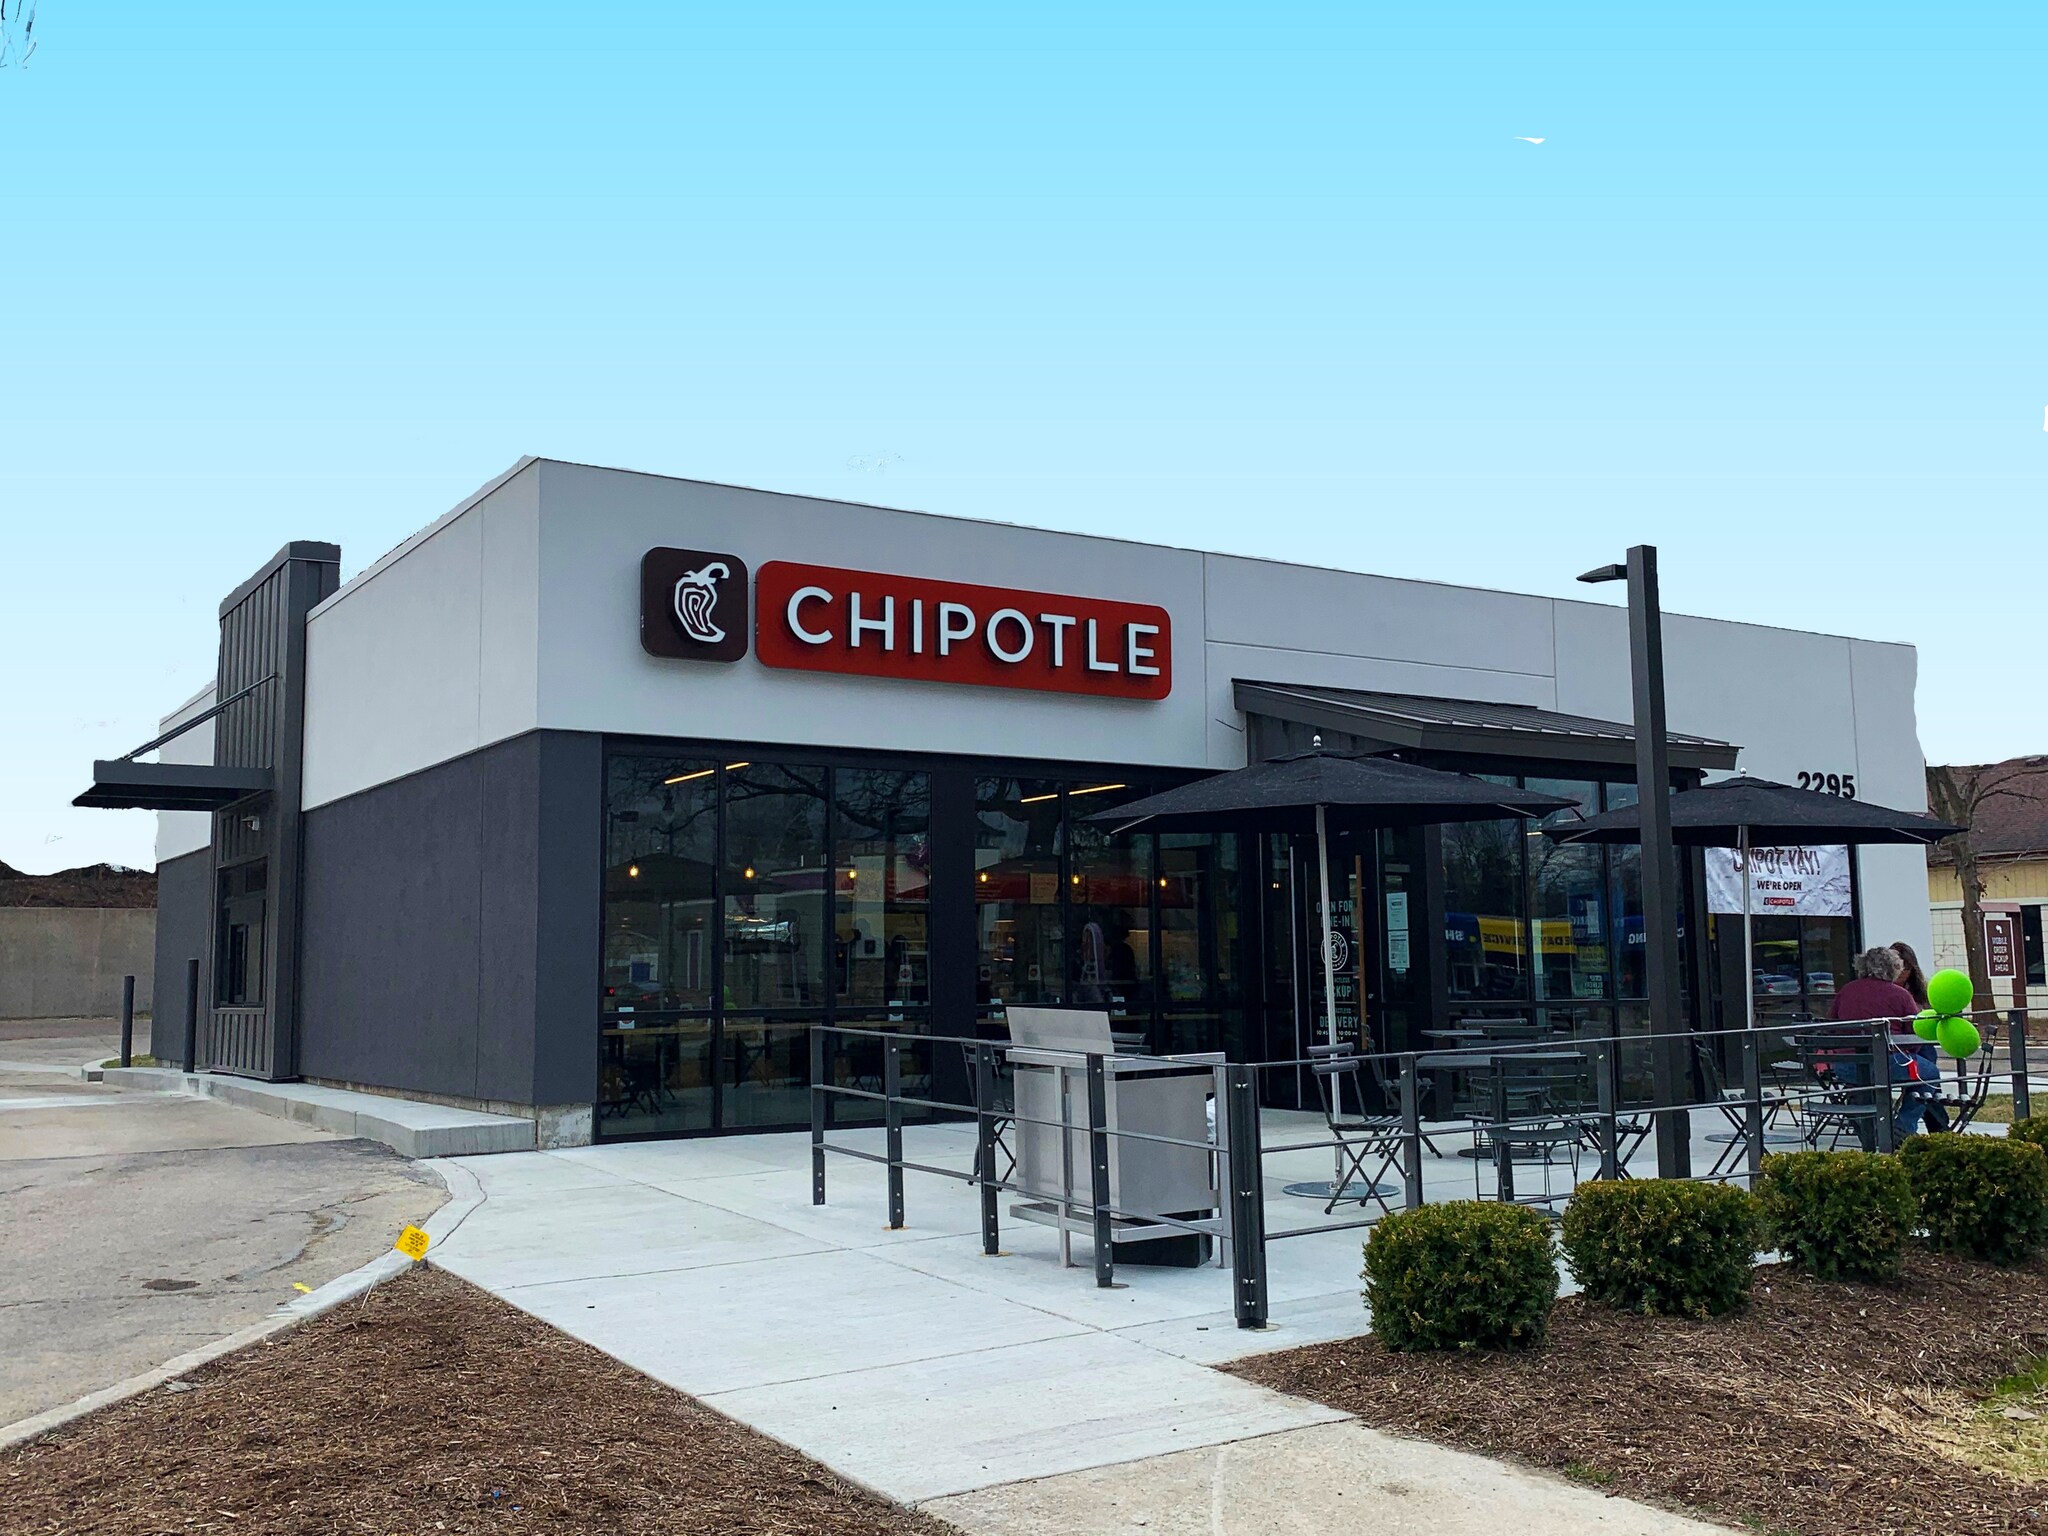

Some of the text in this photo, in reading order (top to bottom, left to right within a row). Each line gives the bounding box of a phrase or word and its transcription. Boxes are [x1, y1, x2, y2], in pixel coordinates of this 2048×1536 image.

[786, 586, 1160, 676] CHIPOTLE
[1797, 771, 1855, 799] 2295
[1731, 847, 1821, 876] CIPOT-YAY!
[1756, 880, 1802, 891] WE'RE OPEN
[1315, 900, 1354, 914] ON FOR
[1993, 946, 2007, 954] ORDER
[1993, 955, 2009, 963] PICKUP
[1995, 964, 2009, 972] AHEAD
[1323, 985, 1352, 998] PKUP
[1319, 1015, 1359, 1029] DEVERY
